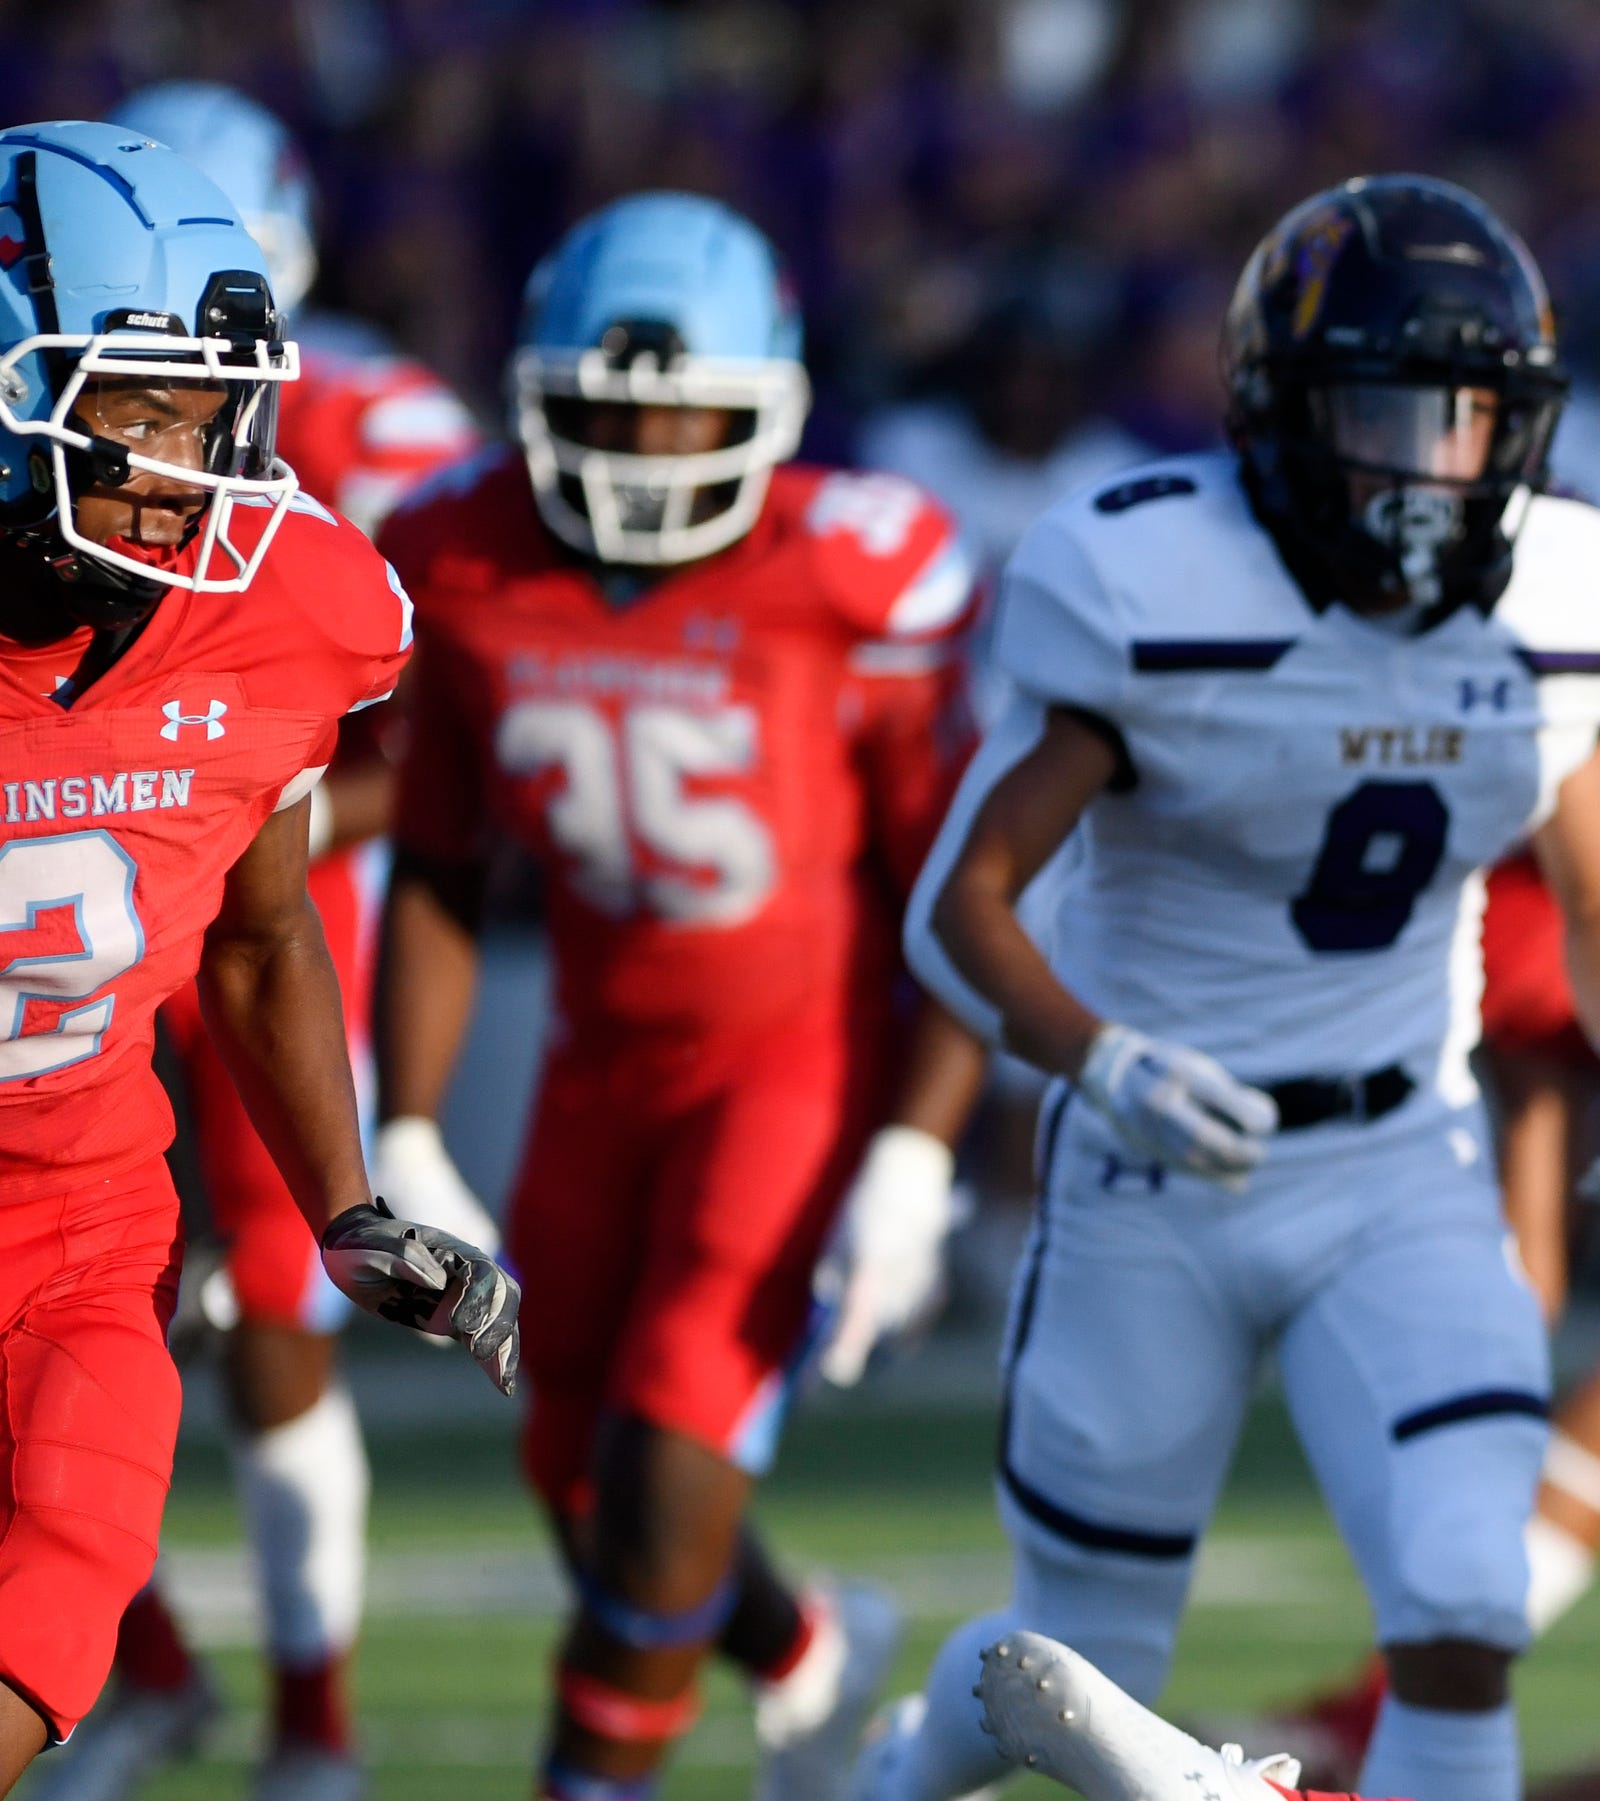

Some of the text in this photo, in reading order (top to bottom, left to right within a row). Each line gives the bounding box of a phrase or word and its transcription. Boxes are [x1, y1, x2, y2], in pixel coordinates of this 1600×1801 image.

[126, 312, 169, 328] schutt
[0, 768, 195, 824] INSMEN
[495, 700, 780, 930] 35
